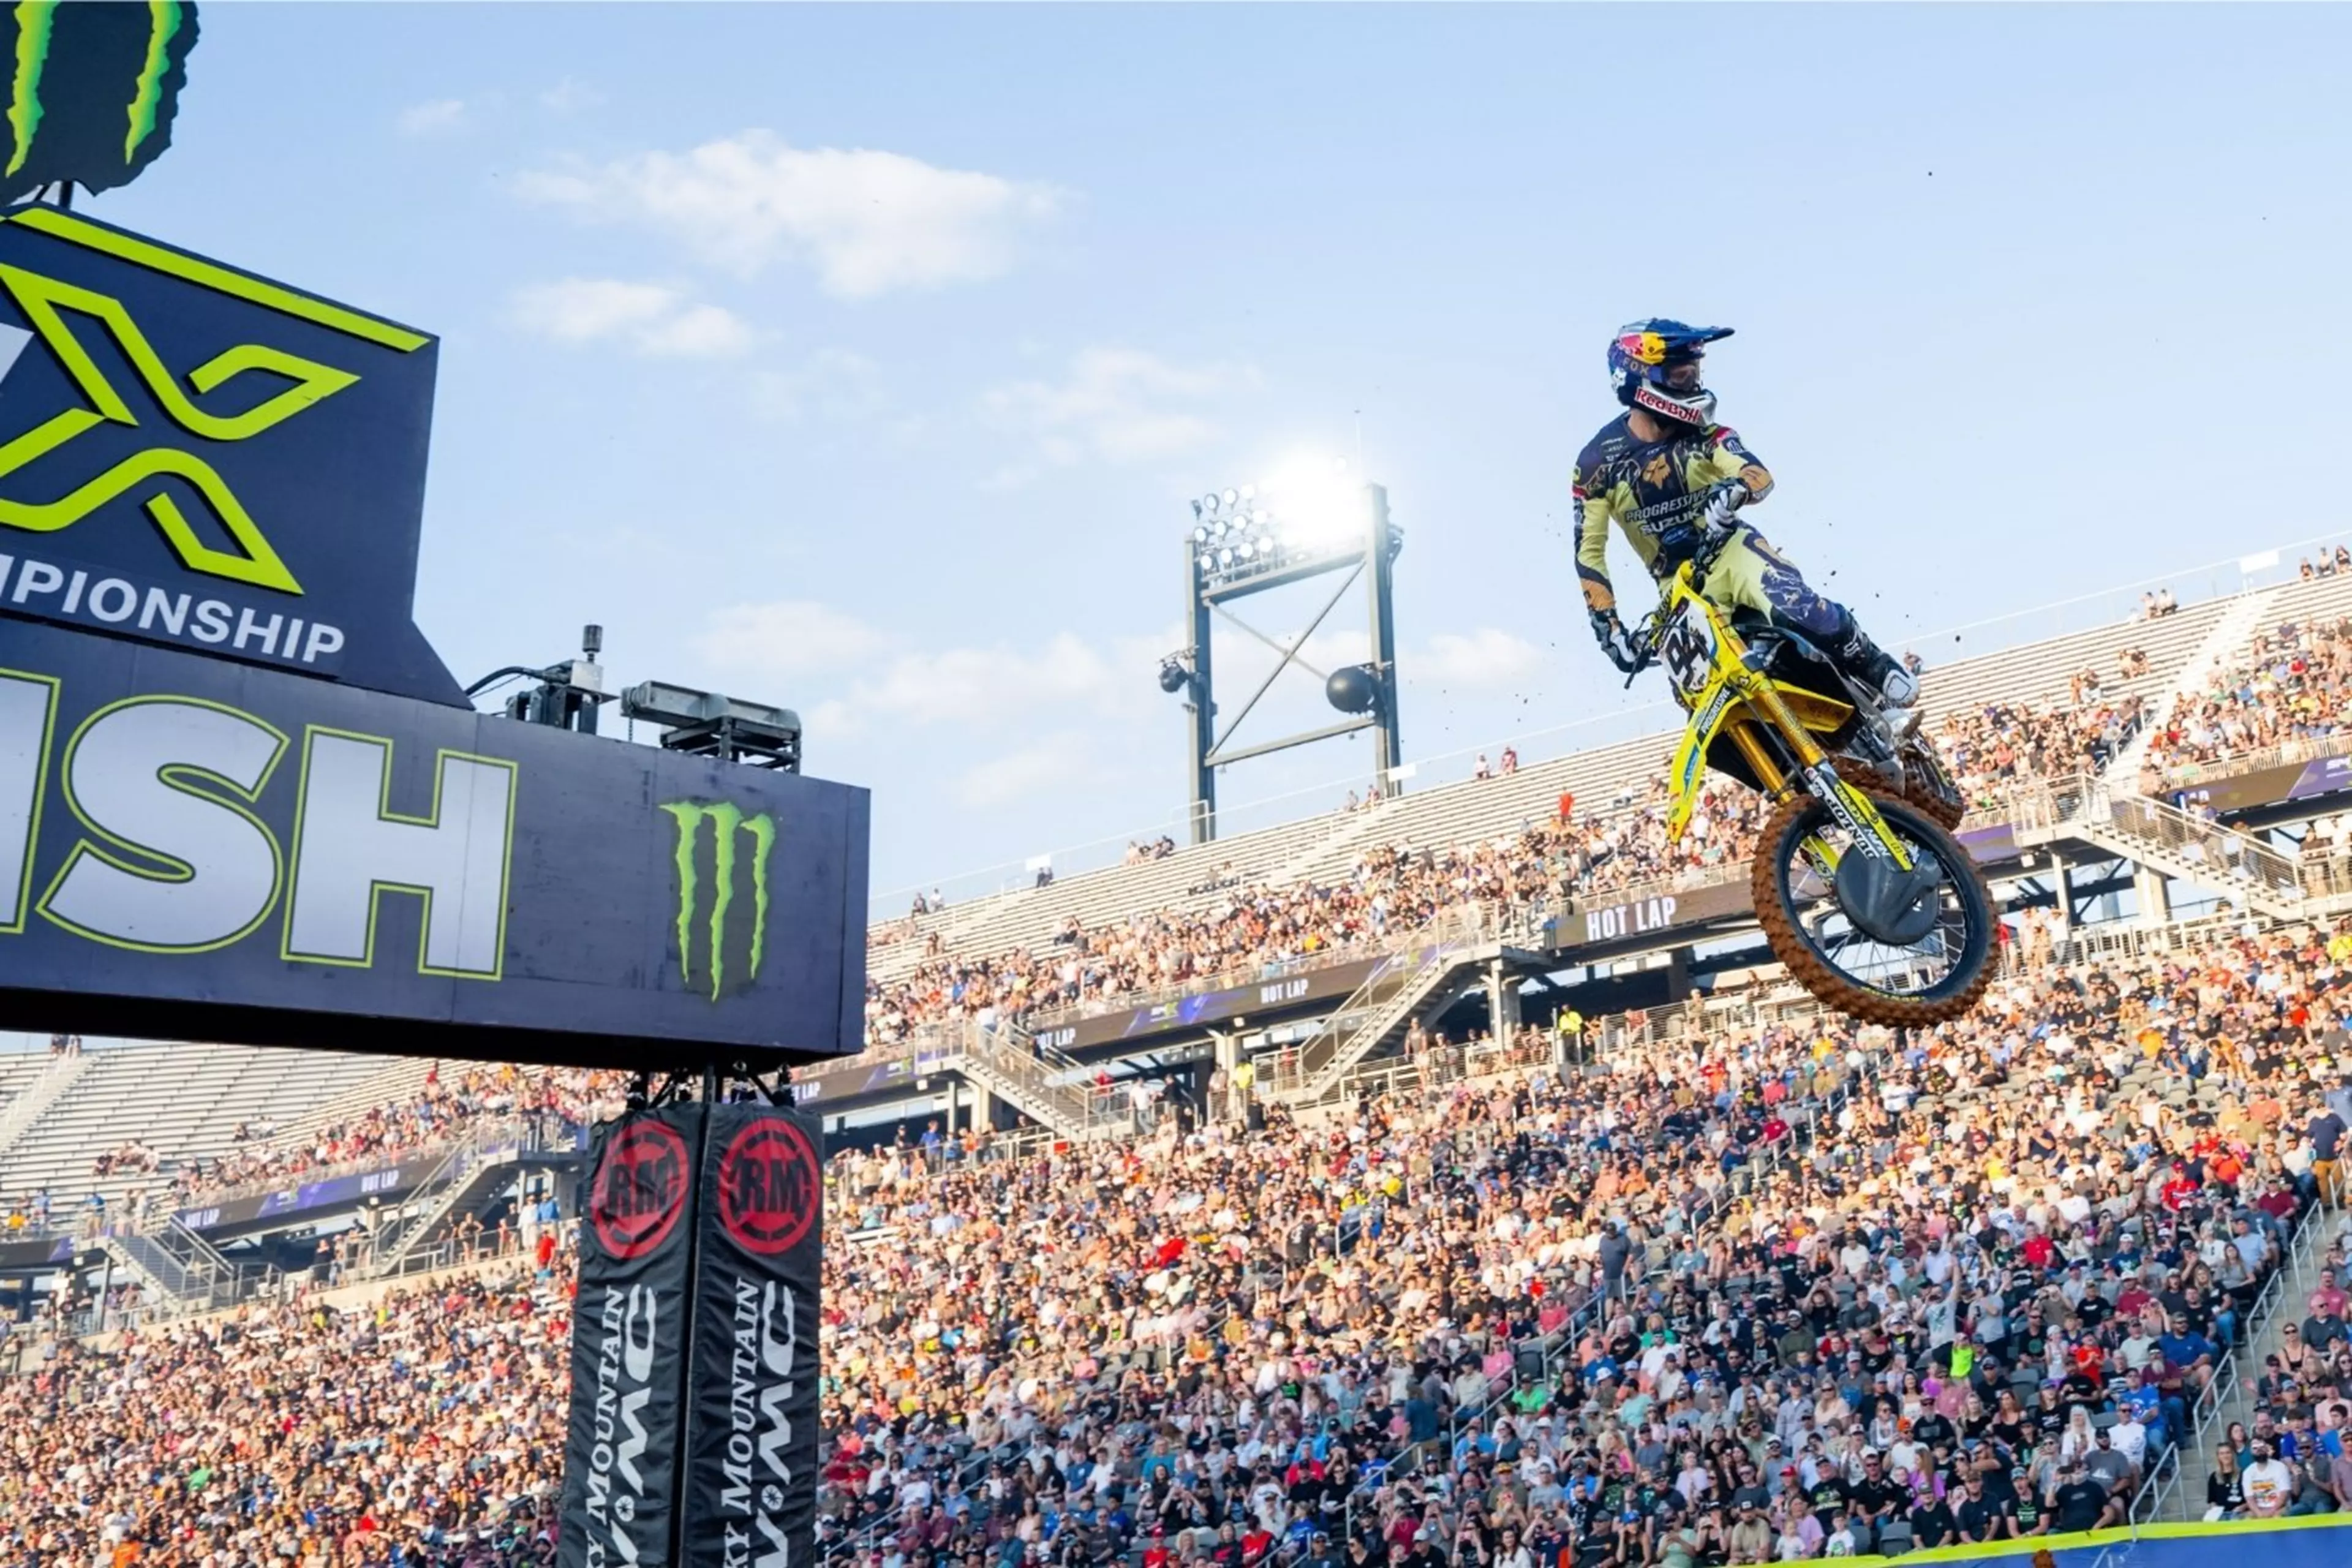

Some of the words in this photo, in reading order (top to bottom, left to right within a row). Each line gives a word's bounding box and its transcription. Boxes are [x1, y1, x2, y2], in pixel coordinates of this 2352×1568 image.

[1623, 358, 1649, 376] FOX
[1636, 388, 1666, 412] Red
[1667, 402, 1700, 422] Bull
[0, 262, 362, 595] X
[1626, 488, 1708, 522] PROGRESSIVE
[1640, 505, 1700, 535] SUZUK
[0, 555, 345, 663] PIONSHIP
[1826, 798, 1875, 859] DUNLOP
[1586, 905, 1627, 941] HOT
[1634, 896, 1678, 932] LAP
[1261, 983, 1283, 1004] HOT
[1287, 979, 1309, 998] LAP
[1056, 1027, 1076, 1047] LAP
[802, 1081, 821, 1101] LAP
[381, 1170, 400, 1189] LAP
[203, 1208, 221, 1226] LAP
[586, 1284, 625, 1526] MOUNTAIN
[720, 1276, 760, 1515] MOUNTAIN
